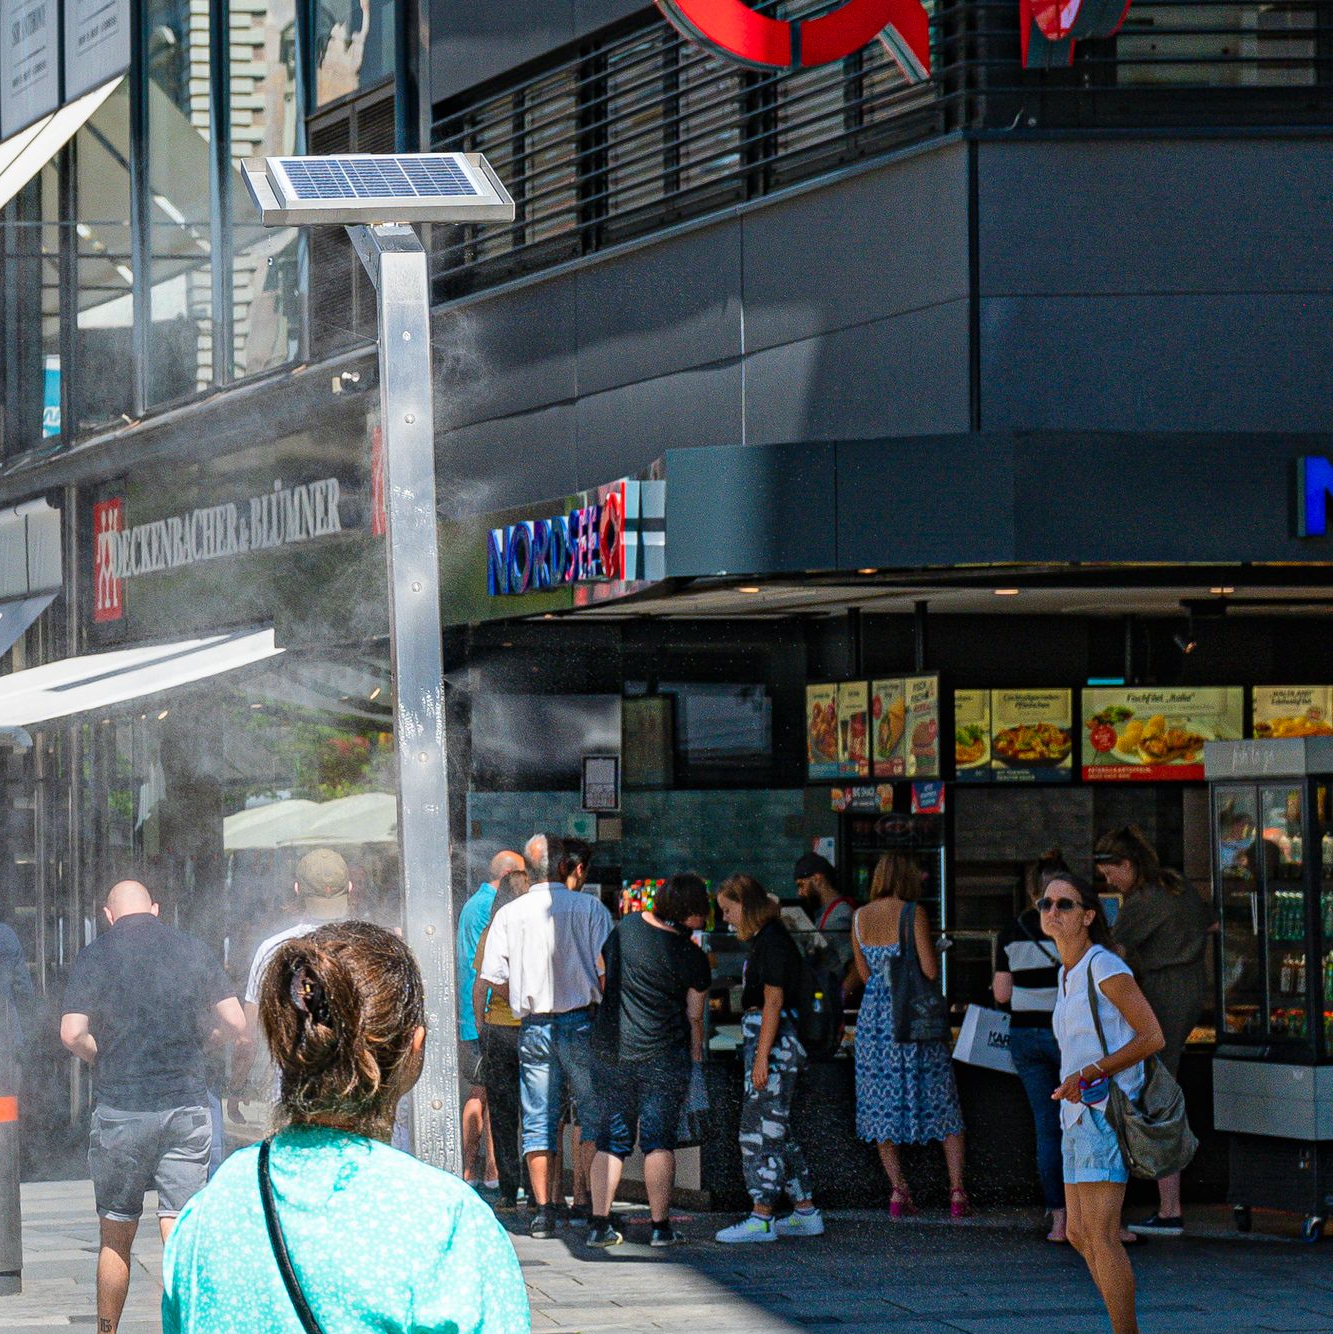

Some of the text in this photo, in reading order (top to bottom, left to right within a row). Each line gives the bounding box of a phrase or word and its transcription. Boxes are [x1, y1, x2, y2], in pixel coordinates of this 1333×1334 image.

[112, 502, 240, 577] DECKENBACHER
[250, 478, 342, 548] BLÜMNER
[487, 505, 603, 597] NORDSEE
